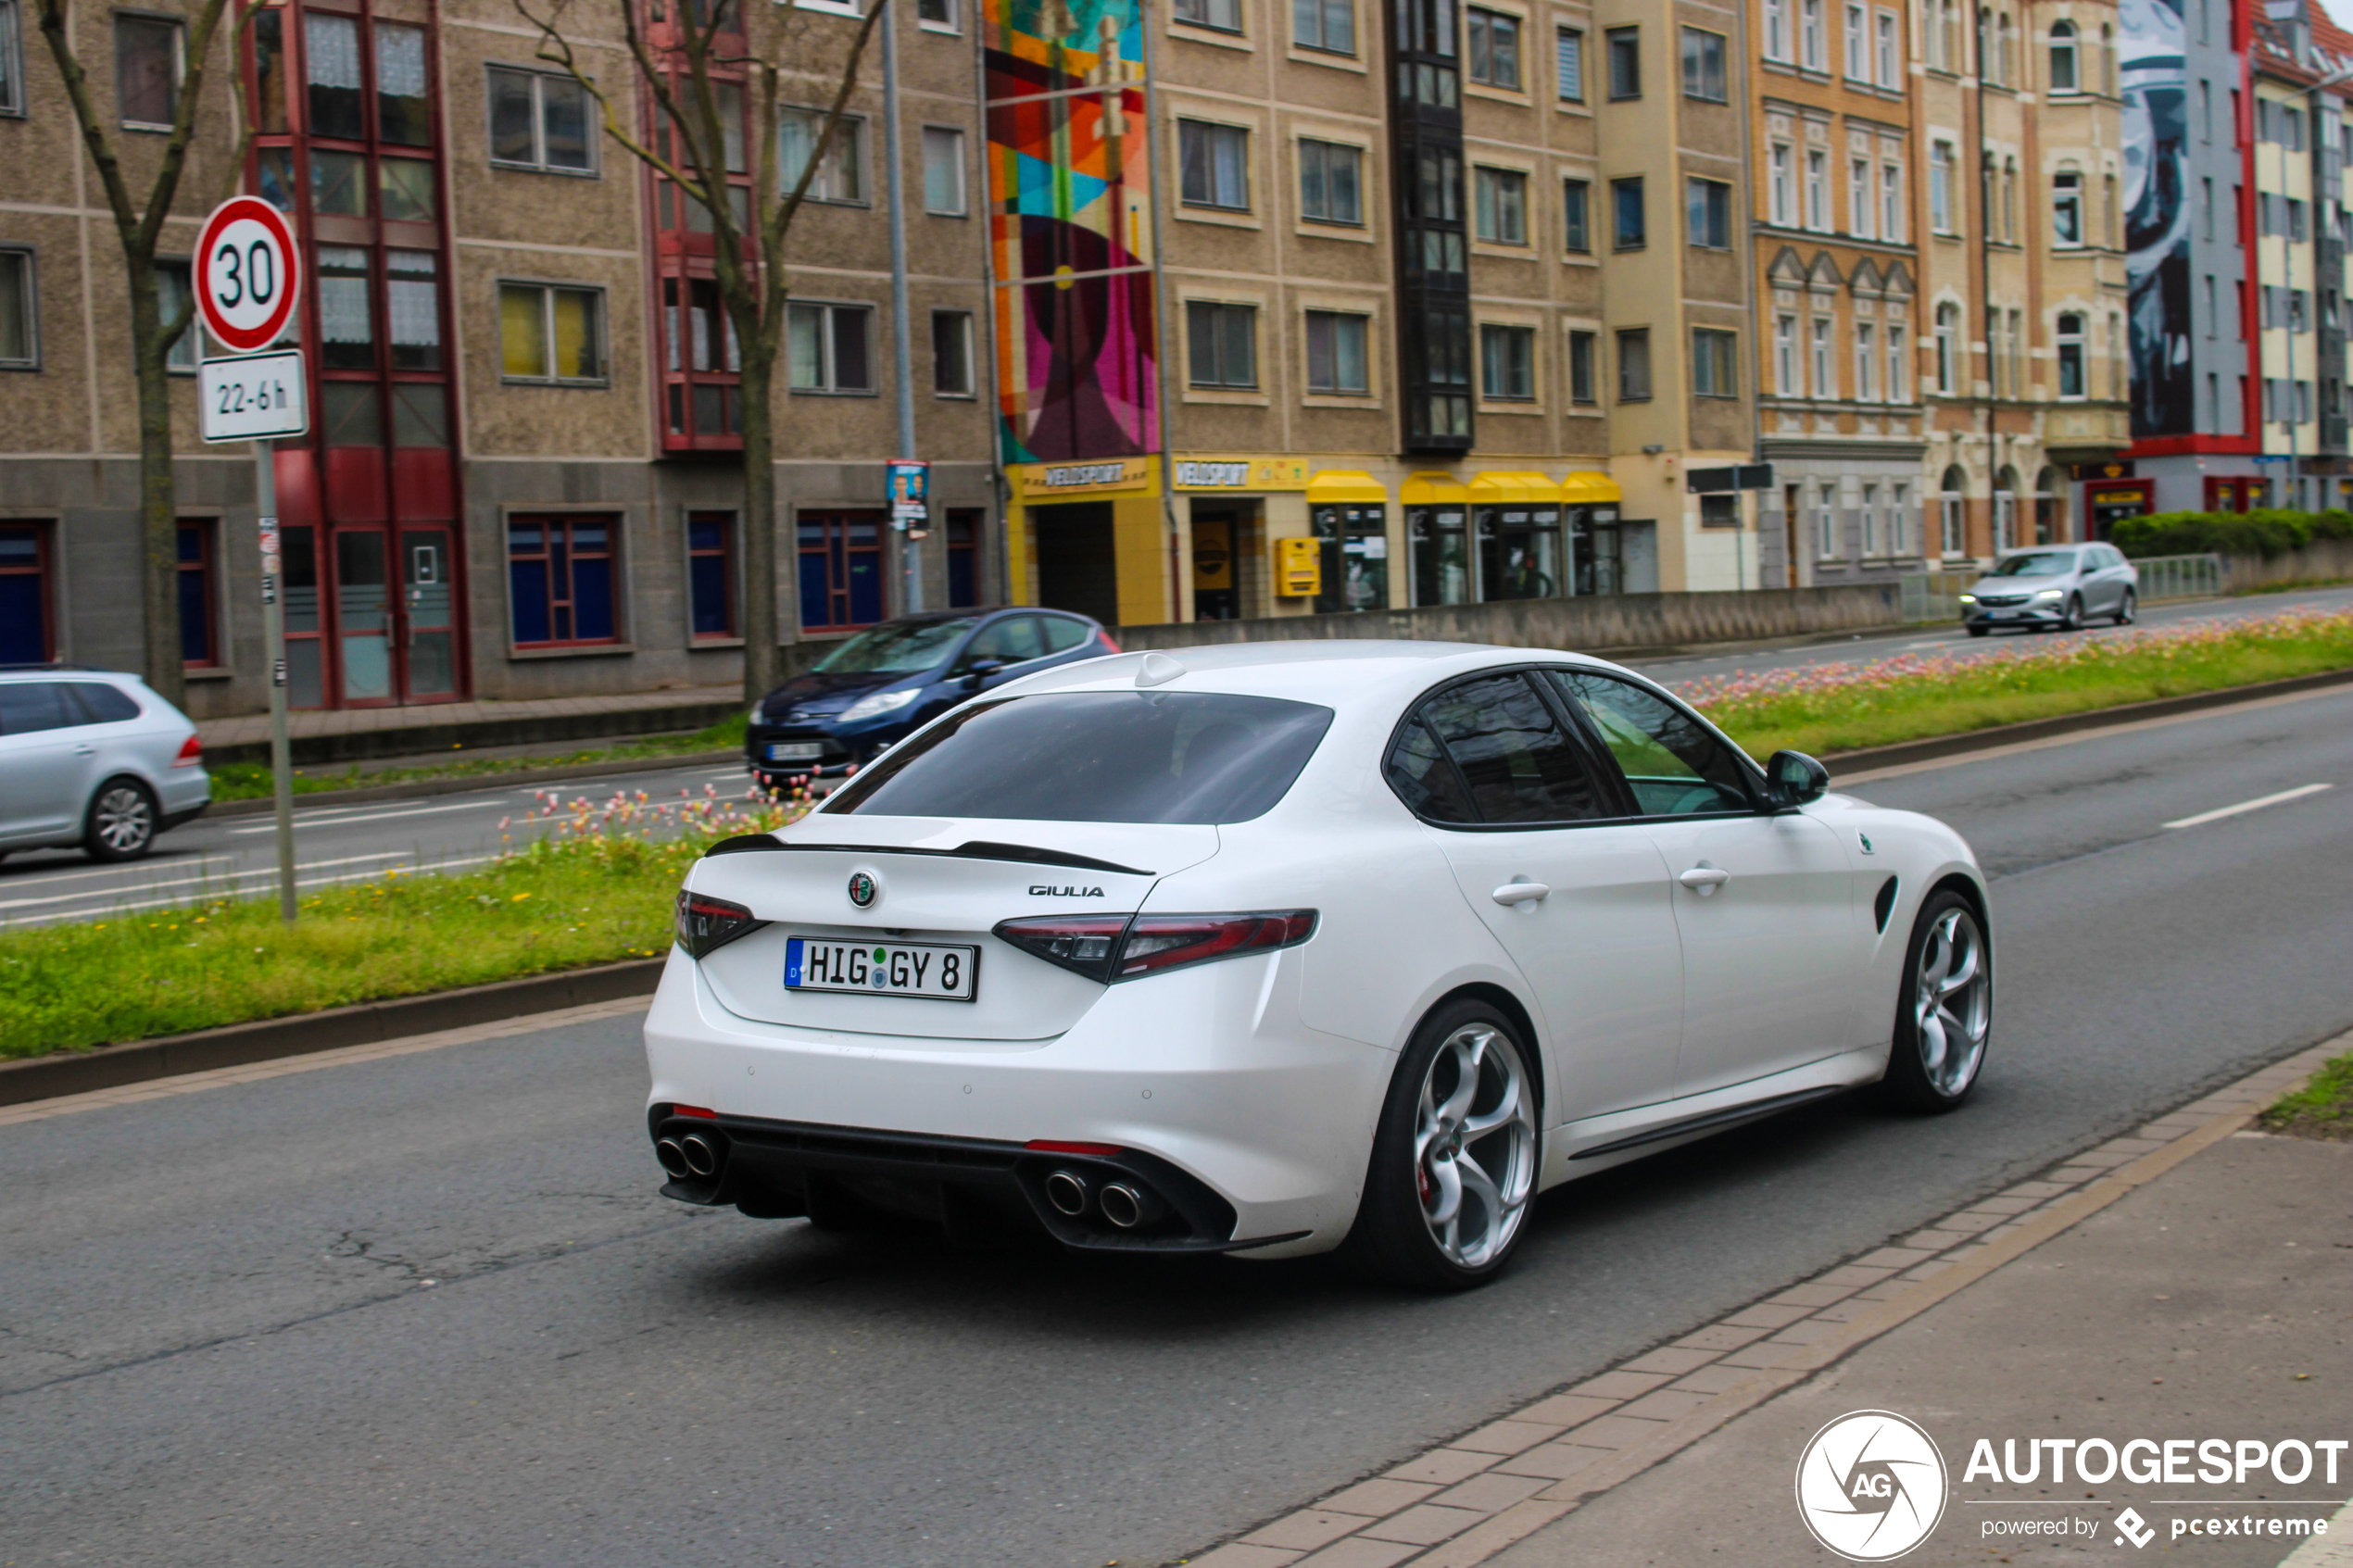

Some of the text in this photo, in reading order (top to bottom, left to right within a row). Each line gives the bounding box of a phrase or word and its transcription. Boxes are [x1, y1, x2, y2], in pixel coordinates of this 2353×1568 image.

[217, 240, 273, 308] 30
[1046, 463, 1124, 486] VELOSPORT
[1176, 461, 1249, 485] VELOSPORT
[1028, 885, 1105, 897] GIULIA
[790, 968, 798, 978] D
[809, 946, 960, 991] HIG GY 8
